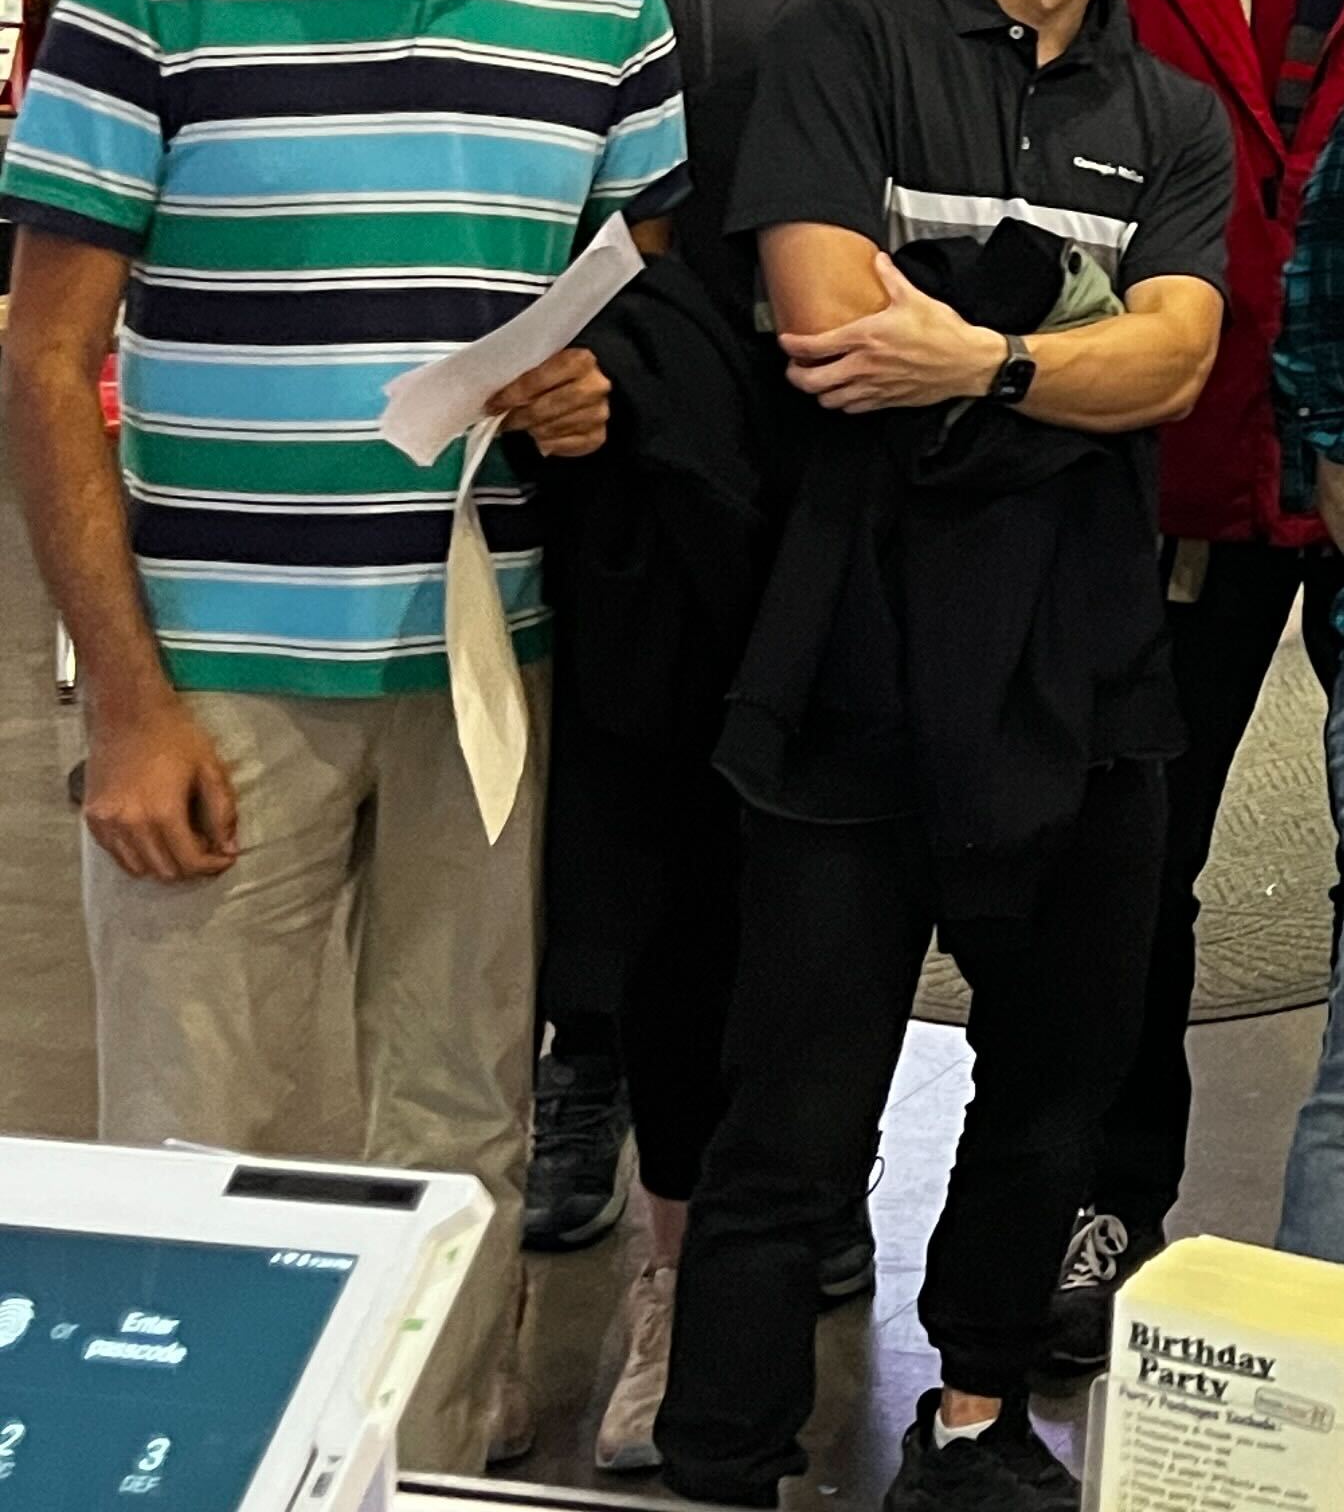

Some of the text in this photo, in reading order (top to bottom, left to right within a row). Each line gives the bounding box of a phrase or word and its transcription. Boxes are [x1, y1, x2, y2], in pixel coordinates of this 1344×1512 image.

[120, 1310, 182, 1336] Enter
[82, 1337, 189, 1365] passcode
[1129, 1319, 1276, 1378] Birthday
[1138, 1354, 1230, 1400] Party
[0, 1422, 173, 1472] 2 3
